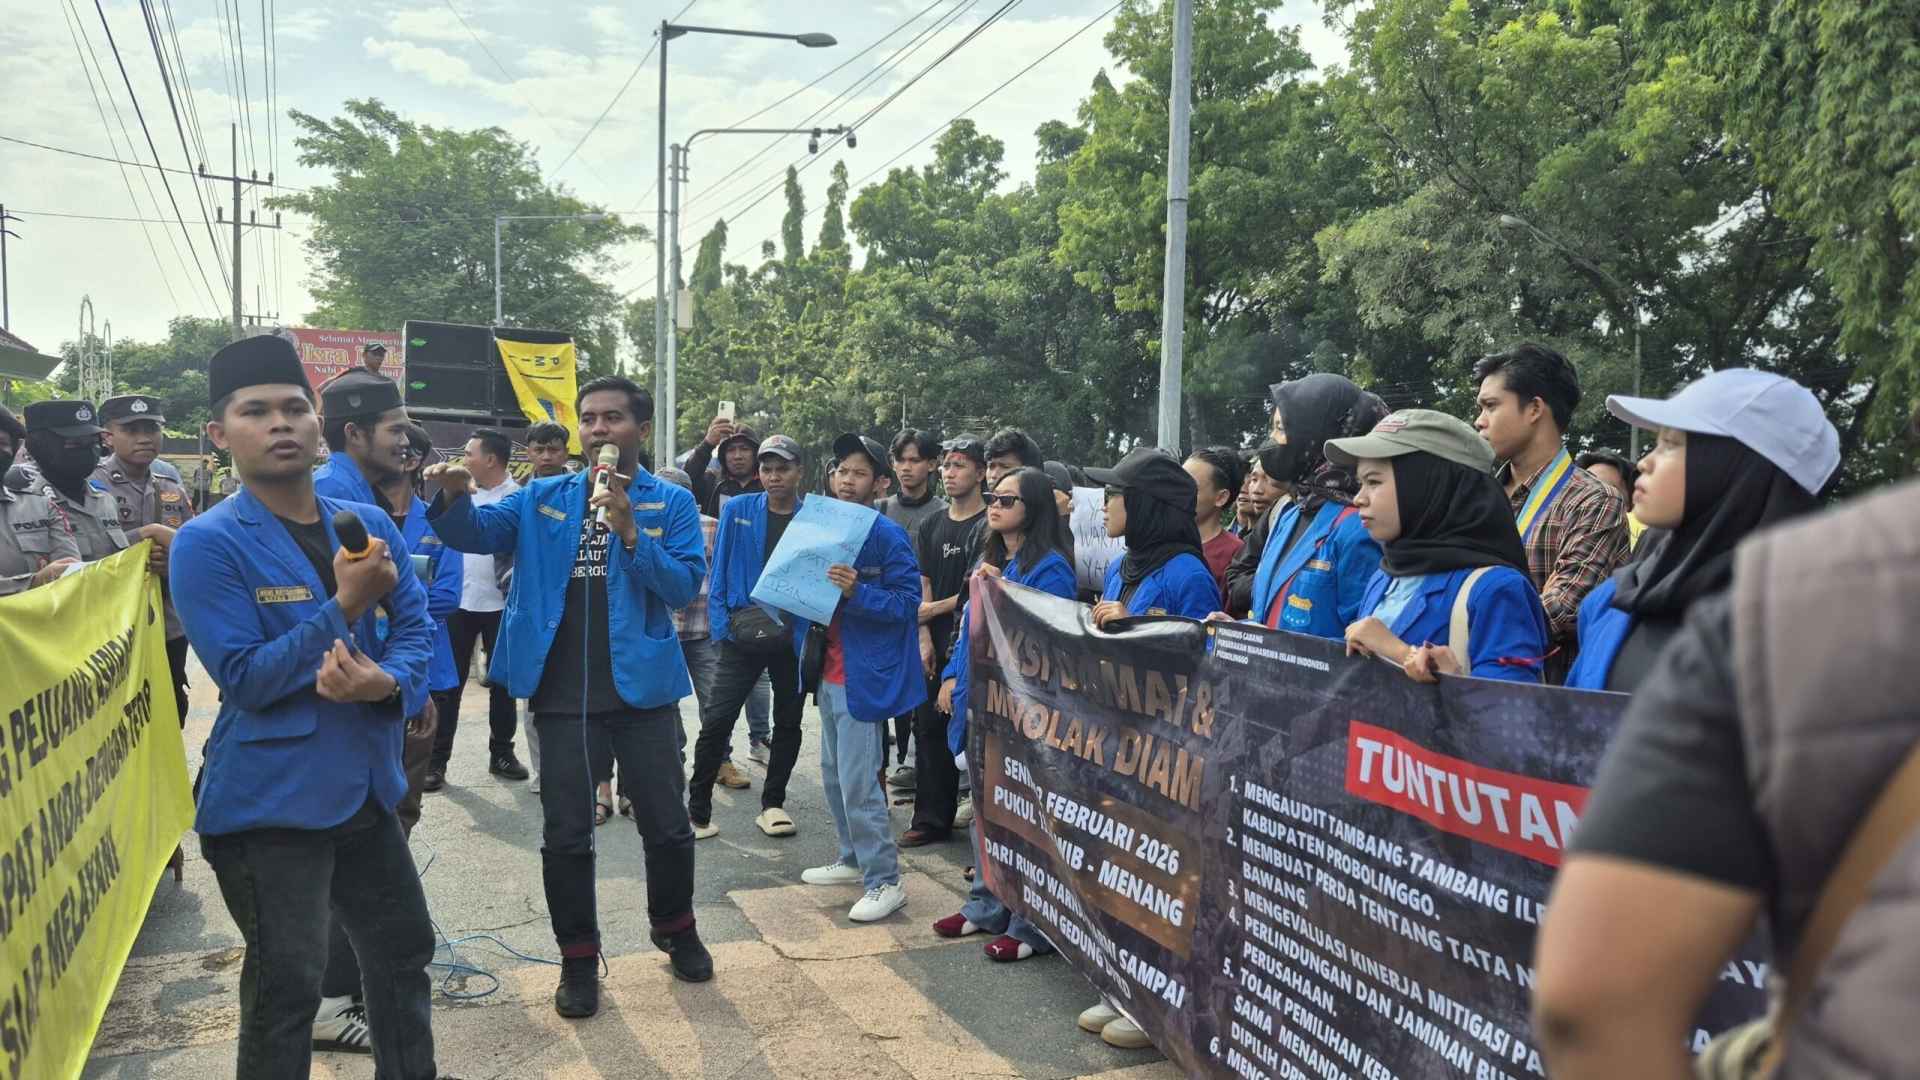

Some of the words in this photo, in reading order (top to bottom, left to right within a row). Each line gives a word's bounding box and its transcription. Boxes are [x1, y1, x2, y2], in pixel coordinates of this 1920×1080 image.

[9, 667, 95, 782] PEJUANG
[1191, 680, 1215, 738] &
[38, 770, 86, 879] ANDA
[85, 718, 130, 808] DENGAN
[1113, 727, 1206, 812] DIAM
[1230, 775, 1238, 794] 1.
[1244, 782, 1328, 831] MENGAUDIT
[994, 785, 1036, 825] PUKUL
[1098, 860, 1184, 927] MENANG
[1046, 791, 1135, 852] FEBRUARI
[1136, 833, 1180, 876] 2026
[1242, 809, 1325, 859] KABUPATEN
[1326, 843, 1440, 920] PROBOLINGGO.
[45, 824, 121, 989] MELAYANI
[984, 837, 1014, 867] DARI
[1016, 849, 1045, 887] RUKO
[1119, 948, 1186, 1009] SAMPAI
[1023, 885, 1058, 927] DEPAN
[1059, 914, 1104, 968] GEDUNG
[1226, 828, 1237, 848] 2.
[1242, 835, 1314, 888] MEMBUAT
[1315, 872, 1358, 912] PERDA
[1359, 892, 1443, 953] TENTANG
[1446, 936, 1511, 982] TATA
[1222, 959, 1234, 979] 5.
[1240, 967, 1282, 1010] TOLAK
[1284, 997, 1362, 1068] PEMILIHAN
[1227, 880, 1239, 900] 3.
[1243, 888, 1348, 963] MENGEVALUASI
[1350, 946, 1423, 1004] KINERJA
[1427, 989, 1511, 1057] MITIGASI
[1228, 907, 1240, 927] 4.
[1244, 914, 1352, 994] PERLINDUNGAN
[1356, 979, 1392, 1025] DAN
[1394, 1004, 1474, 1074] JAMINAN
[1234, 995, 1273, 1036] SAMA
[1243, 940, 1338, 1017] PERUSAHAAN.
[1209, 1036, 1221, 1057] 6.
[1231, 1021, 1279, 1070] DIPILIH
